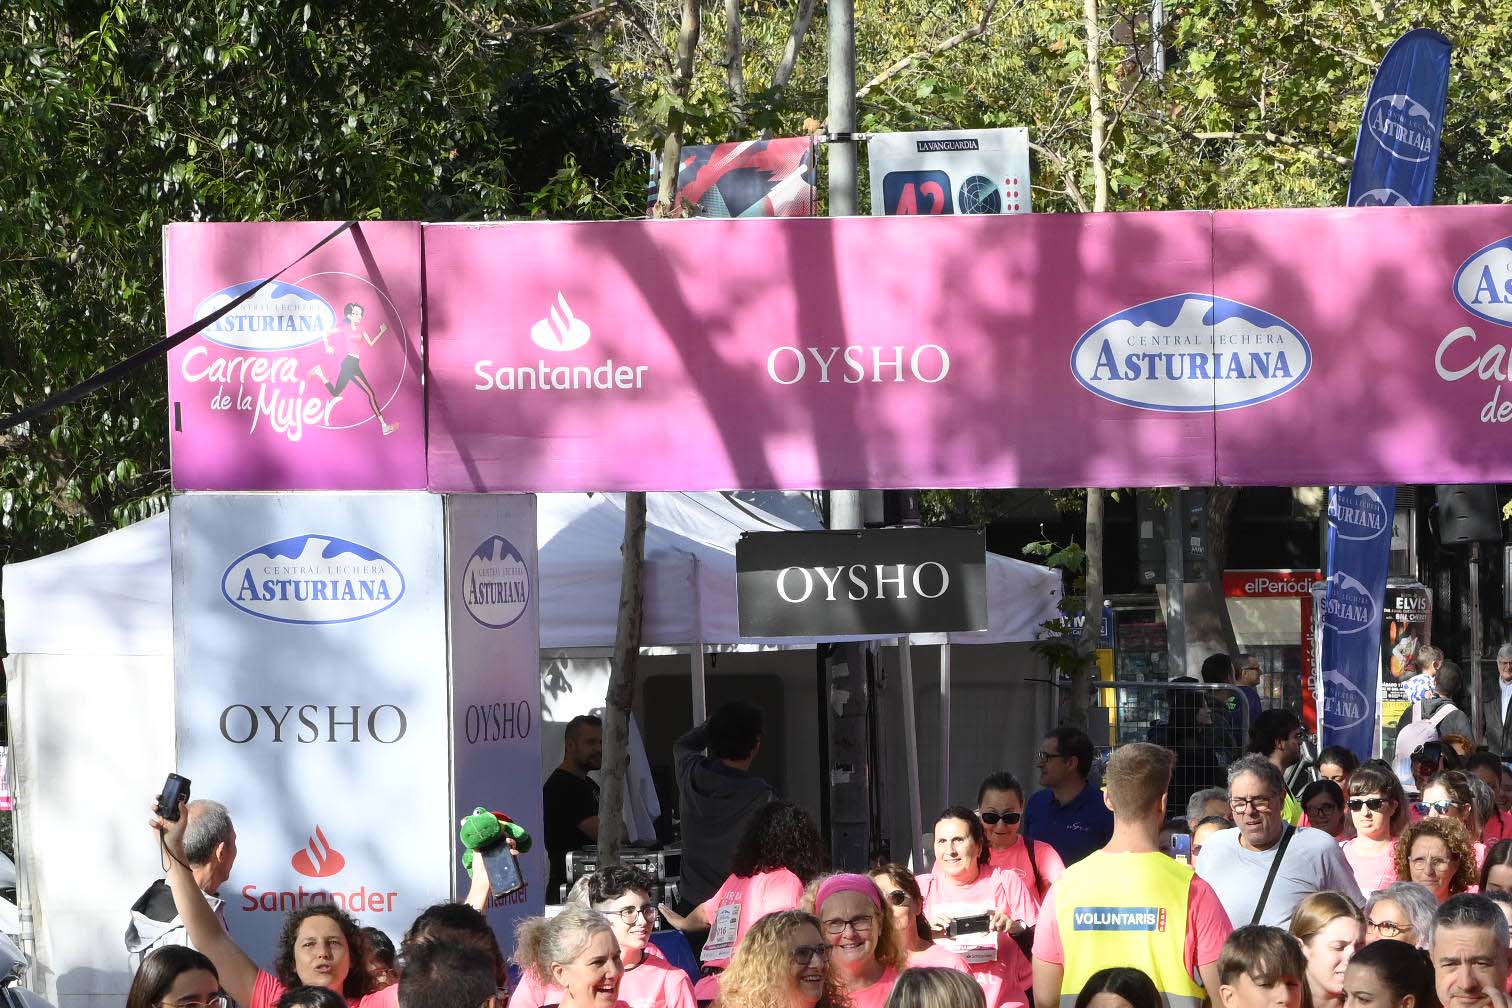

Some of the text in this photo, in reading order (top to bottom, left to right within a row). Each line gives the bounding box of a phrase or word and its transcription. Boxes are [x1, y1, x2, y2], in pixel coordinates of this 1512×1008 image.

[1127, 334, 1285, 346] CENTRAL LECHERA
[181, 346, 301, 384] Carrera
[474, 359, 649, 391] Santander
[767, 344, 950, 385] OYSHO
[1090, 338, 1293, 381] ASTURIANA
[210, 379, 343, 442] de la Mujer
[236, 567, 393, 601] ASTURIANA
[264, 564, 385, 575] CENTRAL LECHERA
[777, 561, 950, 604] OYSHO
[468, 571, 526, 605] ASTURIANA
[1396, 597, 1426, 610] ELVIS
[219, 704, 408, 744] OYSHO
[465, 700, 531, 745] OYSHO
[1075, 913, 1156, 925] VOLUNTARIS
